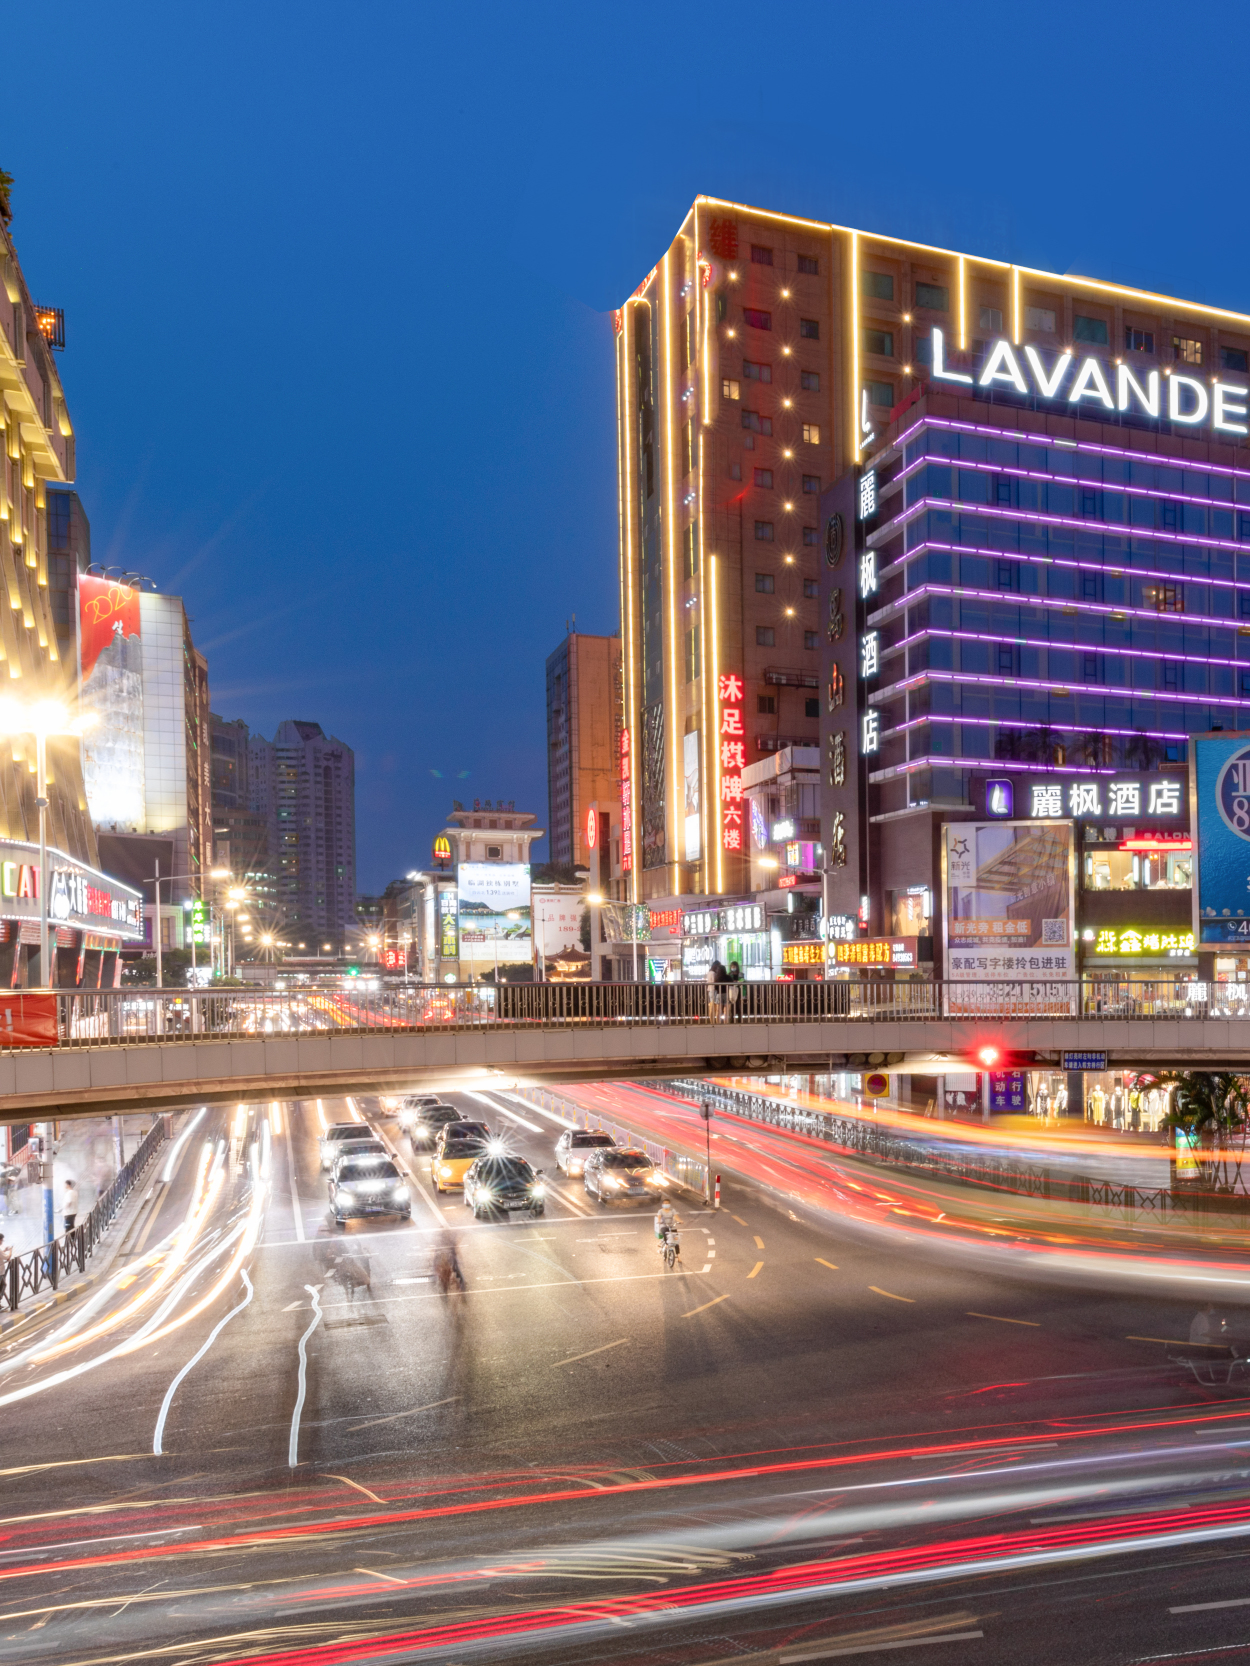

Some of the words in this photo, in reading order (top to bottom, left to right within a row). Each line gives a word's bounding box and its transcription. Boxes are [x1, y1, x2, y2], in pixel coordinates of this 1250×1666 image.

[931, 327, 1249, 435] LAVANDE
[860, 469, 879, 754] 麗枫酒店
[719, 674, 745, 850] 沐足棋牌六楼
[1031, 780, 1180, 817] 麗枫酒店
[951, 957, 1067, 970] 豪配写字楼拎包进驻
[954, 922, 989, 934] 新光旁
[992, 921, 1028, 934] 租金低
